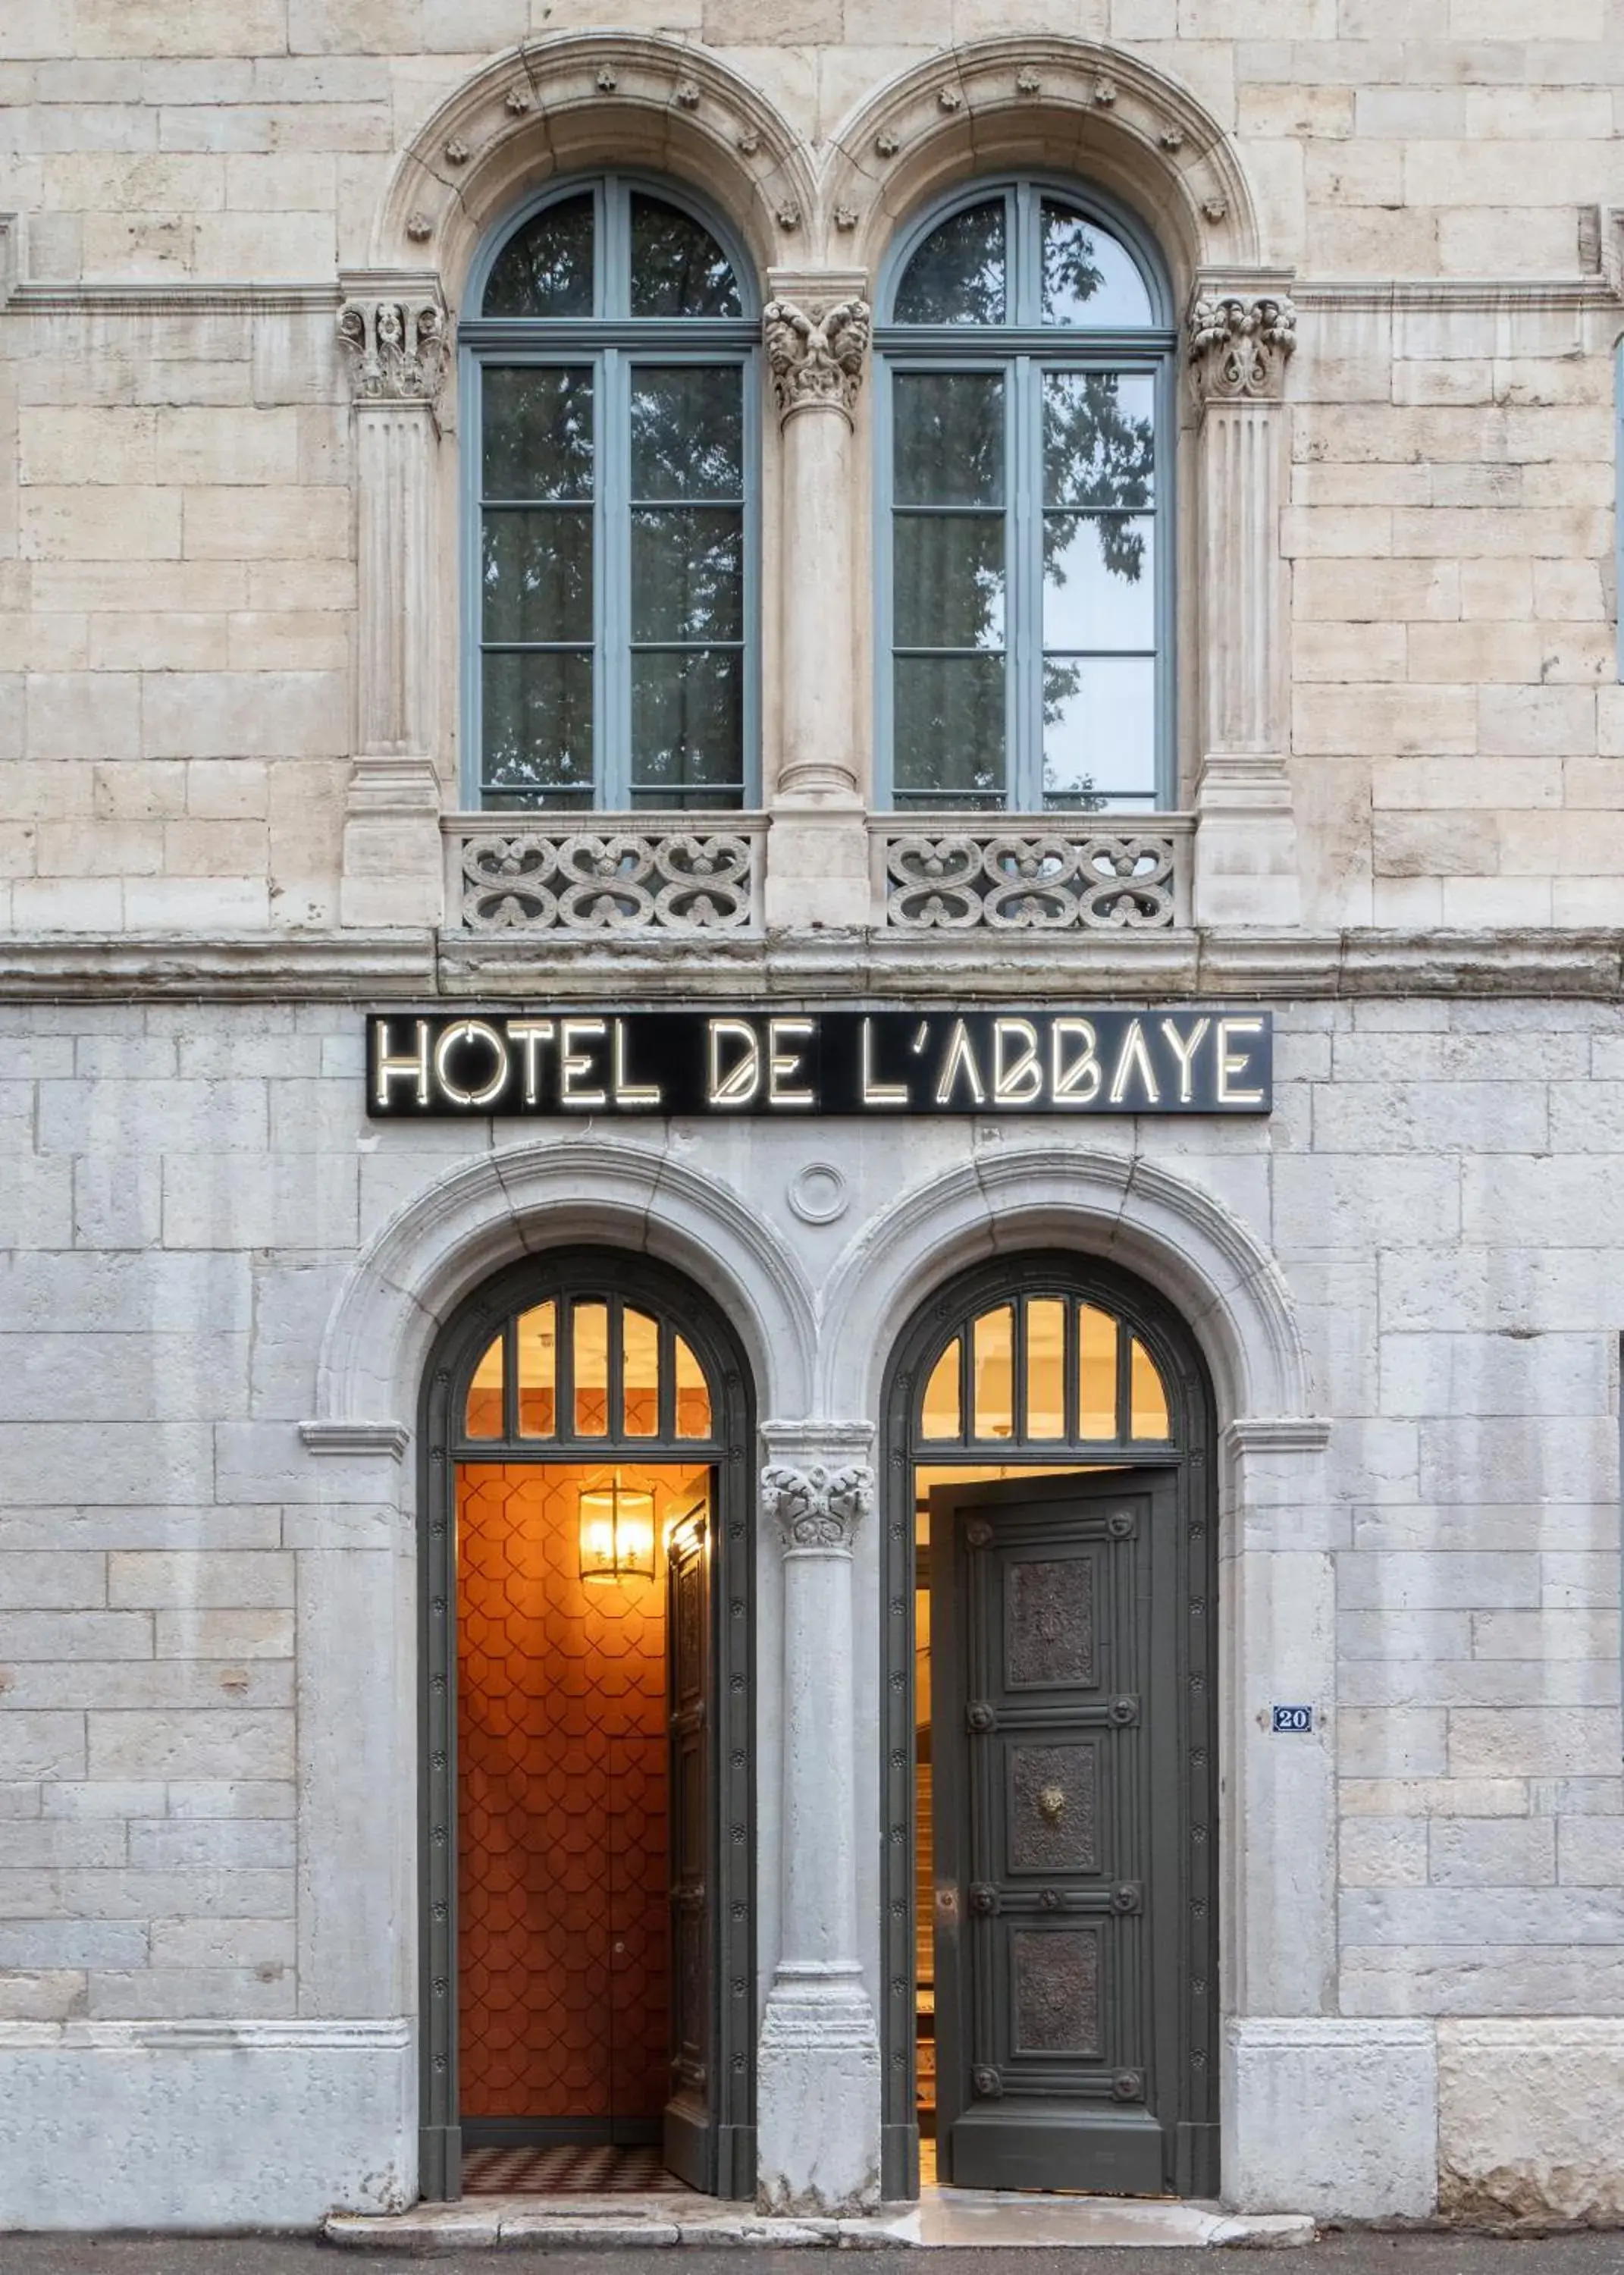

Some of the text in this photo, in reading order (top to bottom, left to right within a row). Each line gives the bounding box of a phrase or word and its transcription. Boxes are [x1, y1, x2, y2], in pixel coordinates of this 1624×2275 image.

[376, 1017, 1263, 1105] HOTEL DE L'ABBAYE
[1279, 1710, 1306, 1727] 20
